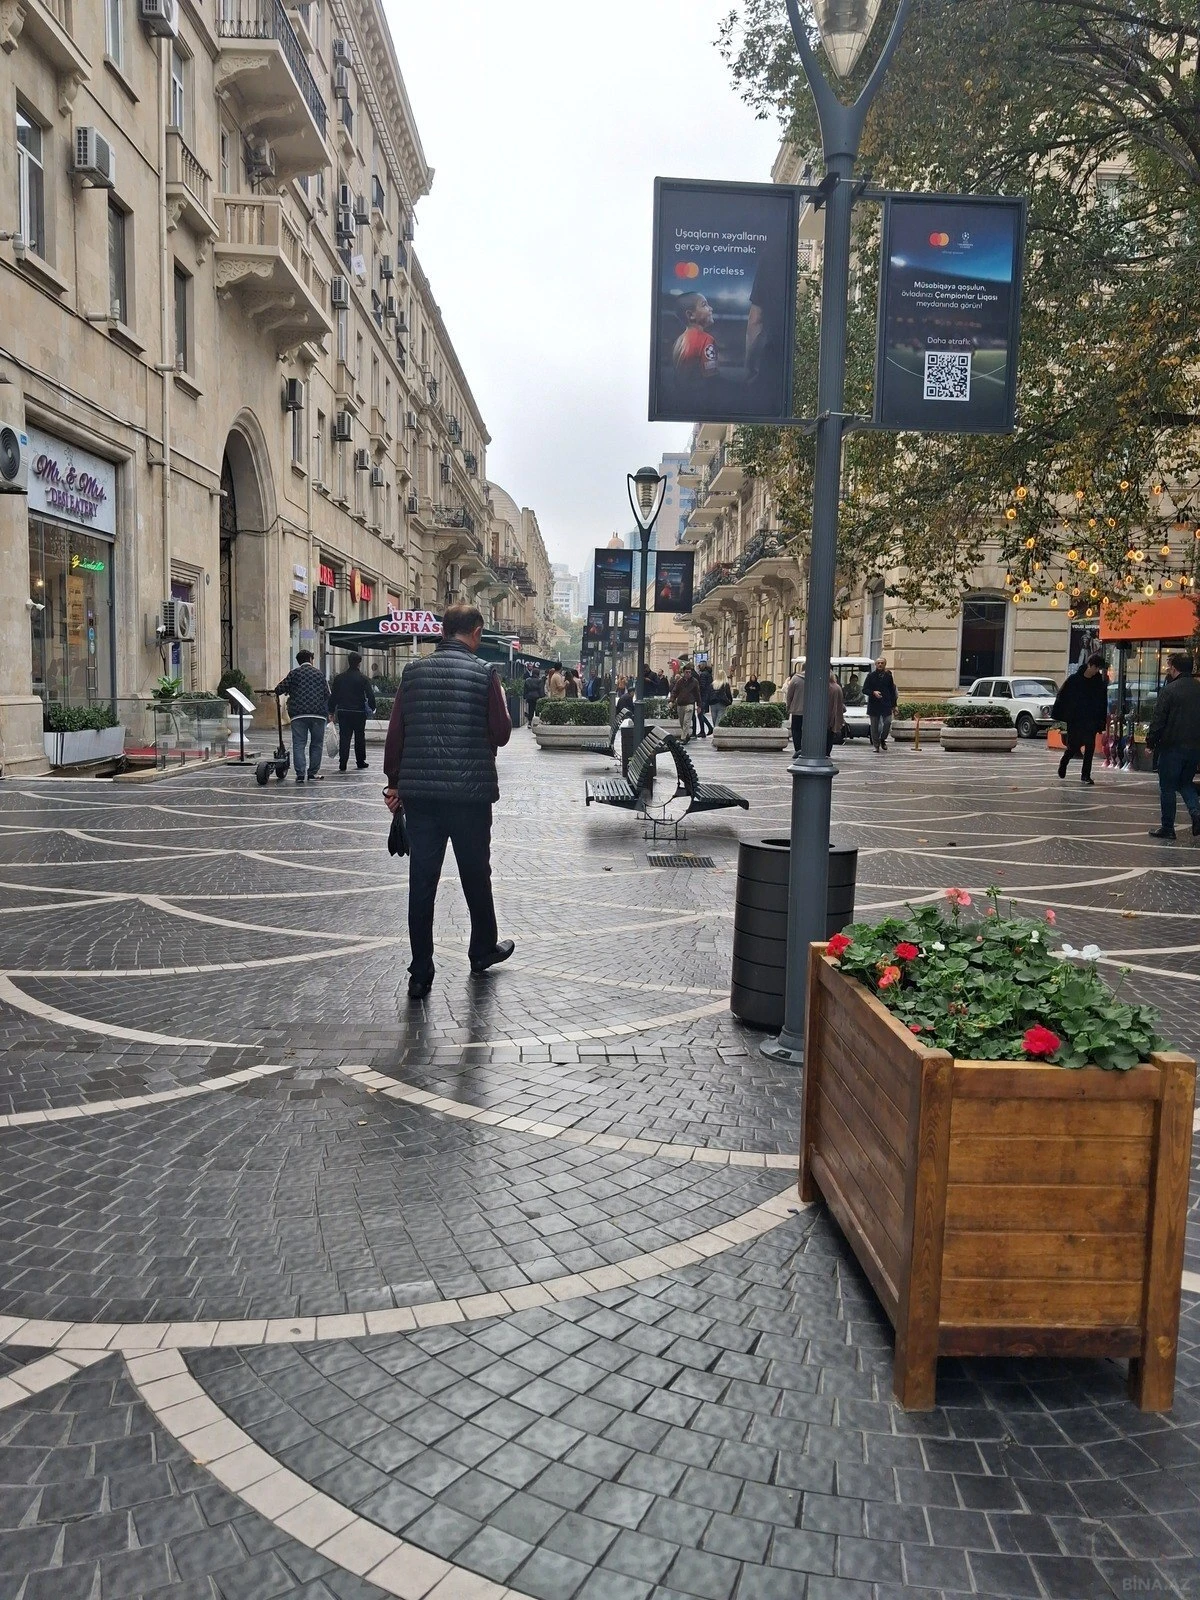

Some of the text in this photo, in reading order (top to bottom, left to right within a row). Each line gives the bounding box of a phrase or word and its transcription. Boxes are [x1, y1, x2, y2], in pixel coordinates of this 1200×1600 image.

[675, 228, 767, 242] Uşaqların xəyallarını
[675, 243, 756, 254] gerçəyə çevirmək:
[702, 265, 744, 276] priceless
[914, 281, 956, 291] Müsabiqəyə
[934, 291, 976, 300] Çempionlar
[916, 300, 959, 309] meydanında
[927, 336, 946, 344] Daha
[67, 466, 77, 491] &
[50, 487, 99, 518] DESI EATERY
[393, 611, 434, 622] URFA
[381, 622, 442, 633] SOFRAS
